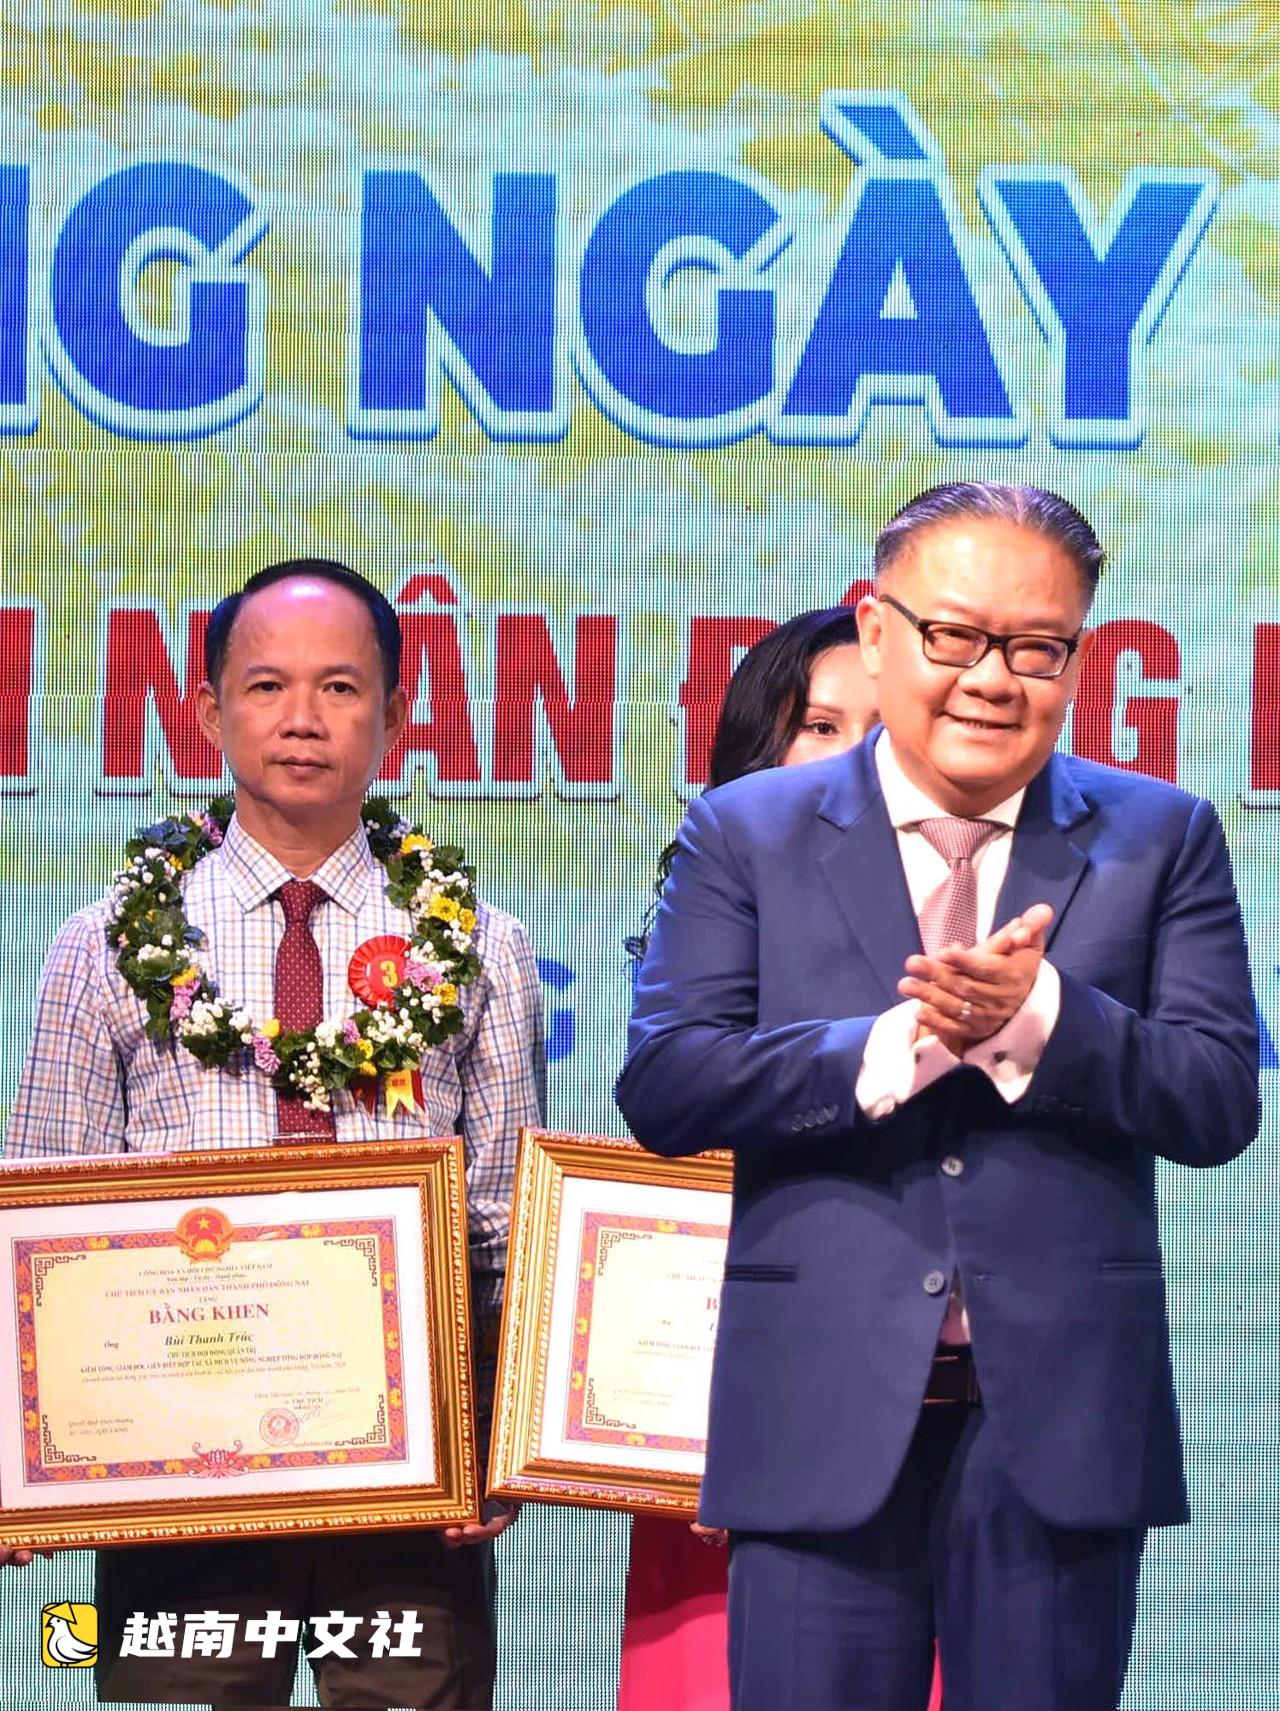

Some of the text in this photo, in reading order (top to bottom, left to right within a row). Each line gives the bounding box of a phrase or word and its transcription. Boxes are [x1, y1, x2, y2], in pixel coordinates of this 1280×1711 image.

[0, 160, 252, 412] G
[358, 102, 1208, 422] NGÀY
[103, 572, 618, 784] NÂN
[379, 960, 398, 988] 3
[149, 1301, 270, 1325] BẰNG KHEN
[165, 1334, 184, 1346] Bùi
[189, 1332, 224, 1345] Thanh
